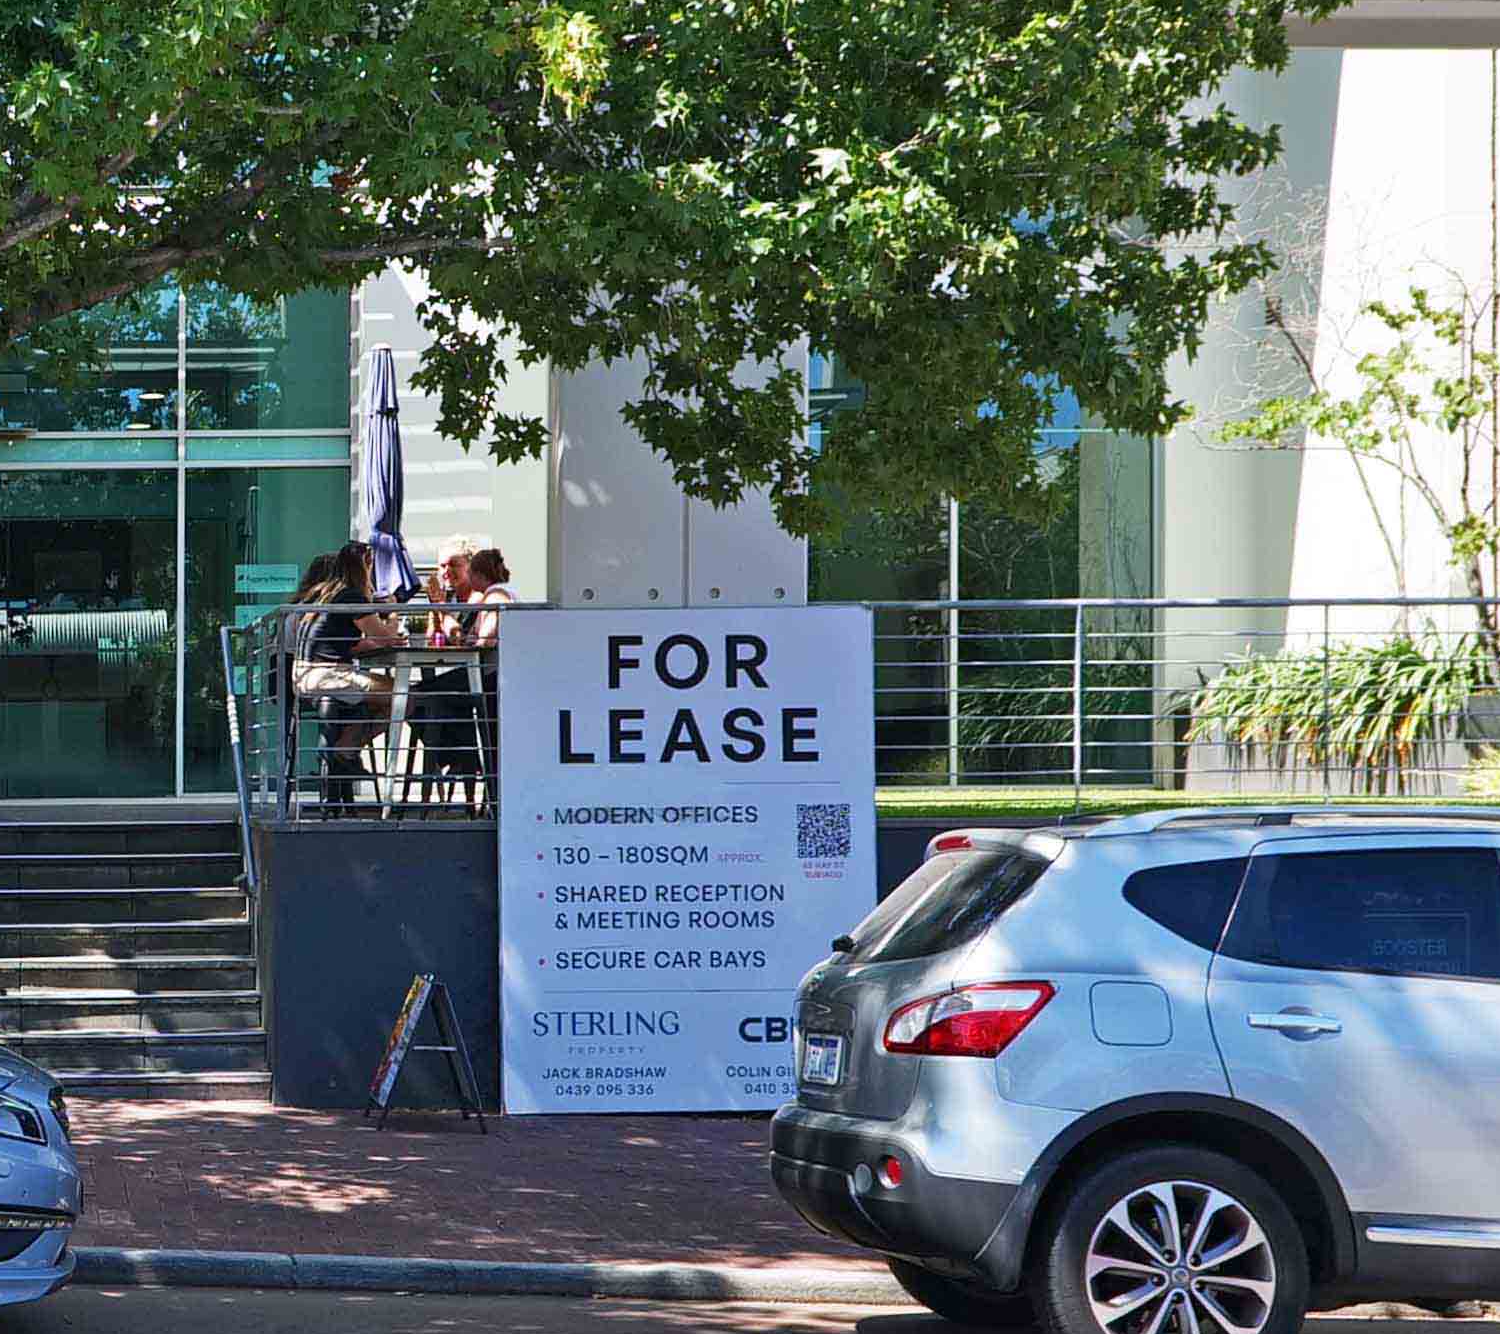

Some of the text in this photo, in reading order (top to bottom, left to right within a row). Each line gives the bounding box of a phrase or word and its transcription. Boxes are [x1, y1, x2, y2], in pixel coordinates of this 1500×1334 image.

[608, 633, 769, 690] FOR
[559, 707, 819, 764] LEASE
[553, 805, 759, 825] MODERN OFFICES
[553, 846, 591, 865] 130
[616, 845, 709, 866] 180SQM
[554, 884, 785, 903] SHARED RECEPTION
[554, 910, 776, 930] & MEETING ROOMS
[555, 950, 767, 970] SECURE CAR BAYS
[532, 1011, 681, 1037] STERLING
[542, 1067, 668, 1079] JACK BRADSHAW
[726, 1066, 770, 1078] COLIN
[555, 1084, 654, 1096] 0439 095 336
[744, 1083, 776, 1094] 0410
